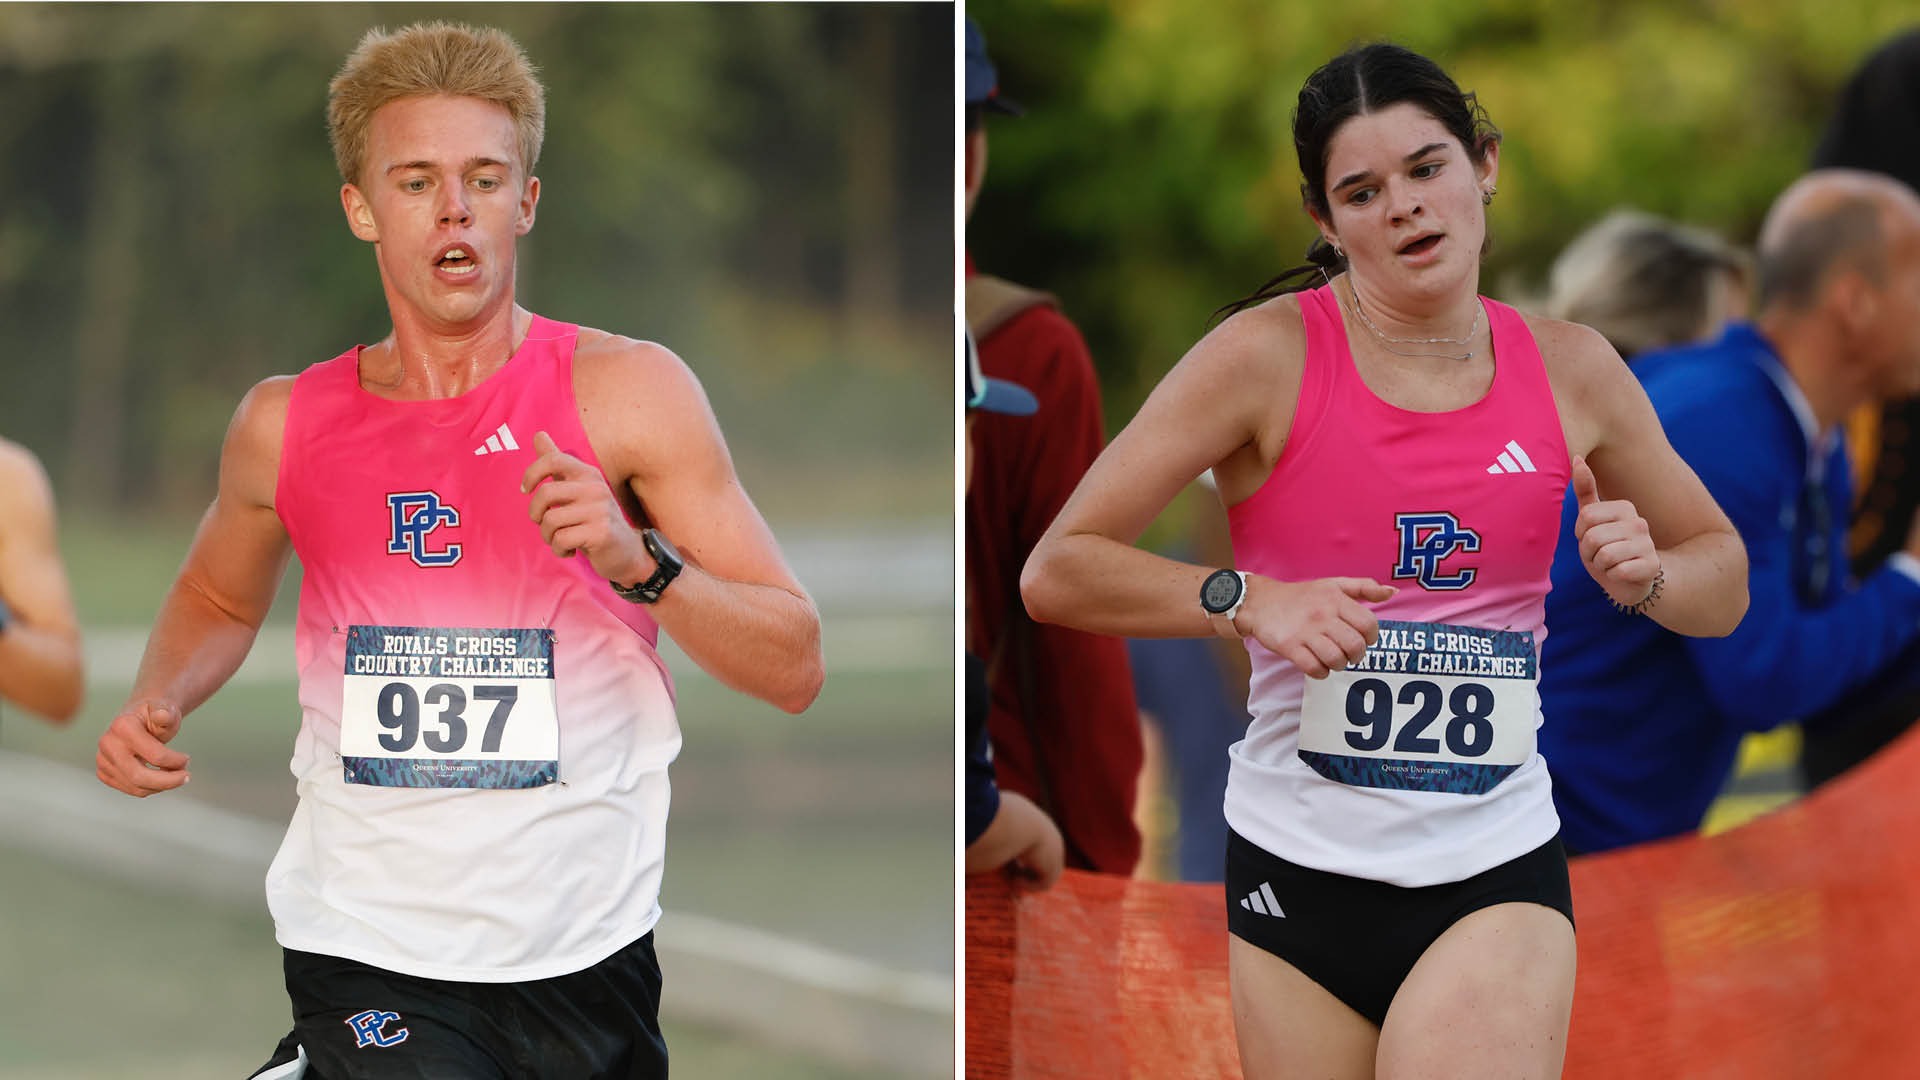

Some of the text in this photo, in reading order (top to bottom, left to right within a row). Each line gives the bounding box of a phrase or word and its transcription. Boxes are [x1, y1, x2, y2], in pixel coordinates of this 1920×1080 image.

[386, 490, 463, 568] PC
[1392, 511, 1482, 591] PC
[383, 635, 517, 656] ROYALS CROSS
[1367, 629, 1494, 655] YALS CROSS
[355, 655, 548, 676] COUNTRY CHALLENGE
[1346, 649, 1527, 677] NTRY CHALLENGE
[377, 682, 518, 753] 937
[1344, 677, 1495, 757] 928
[345, 1009, 409, 1048] PC
